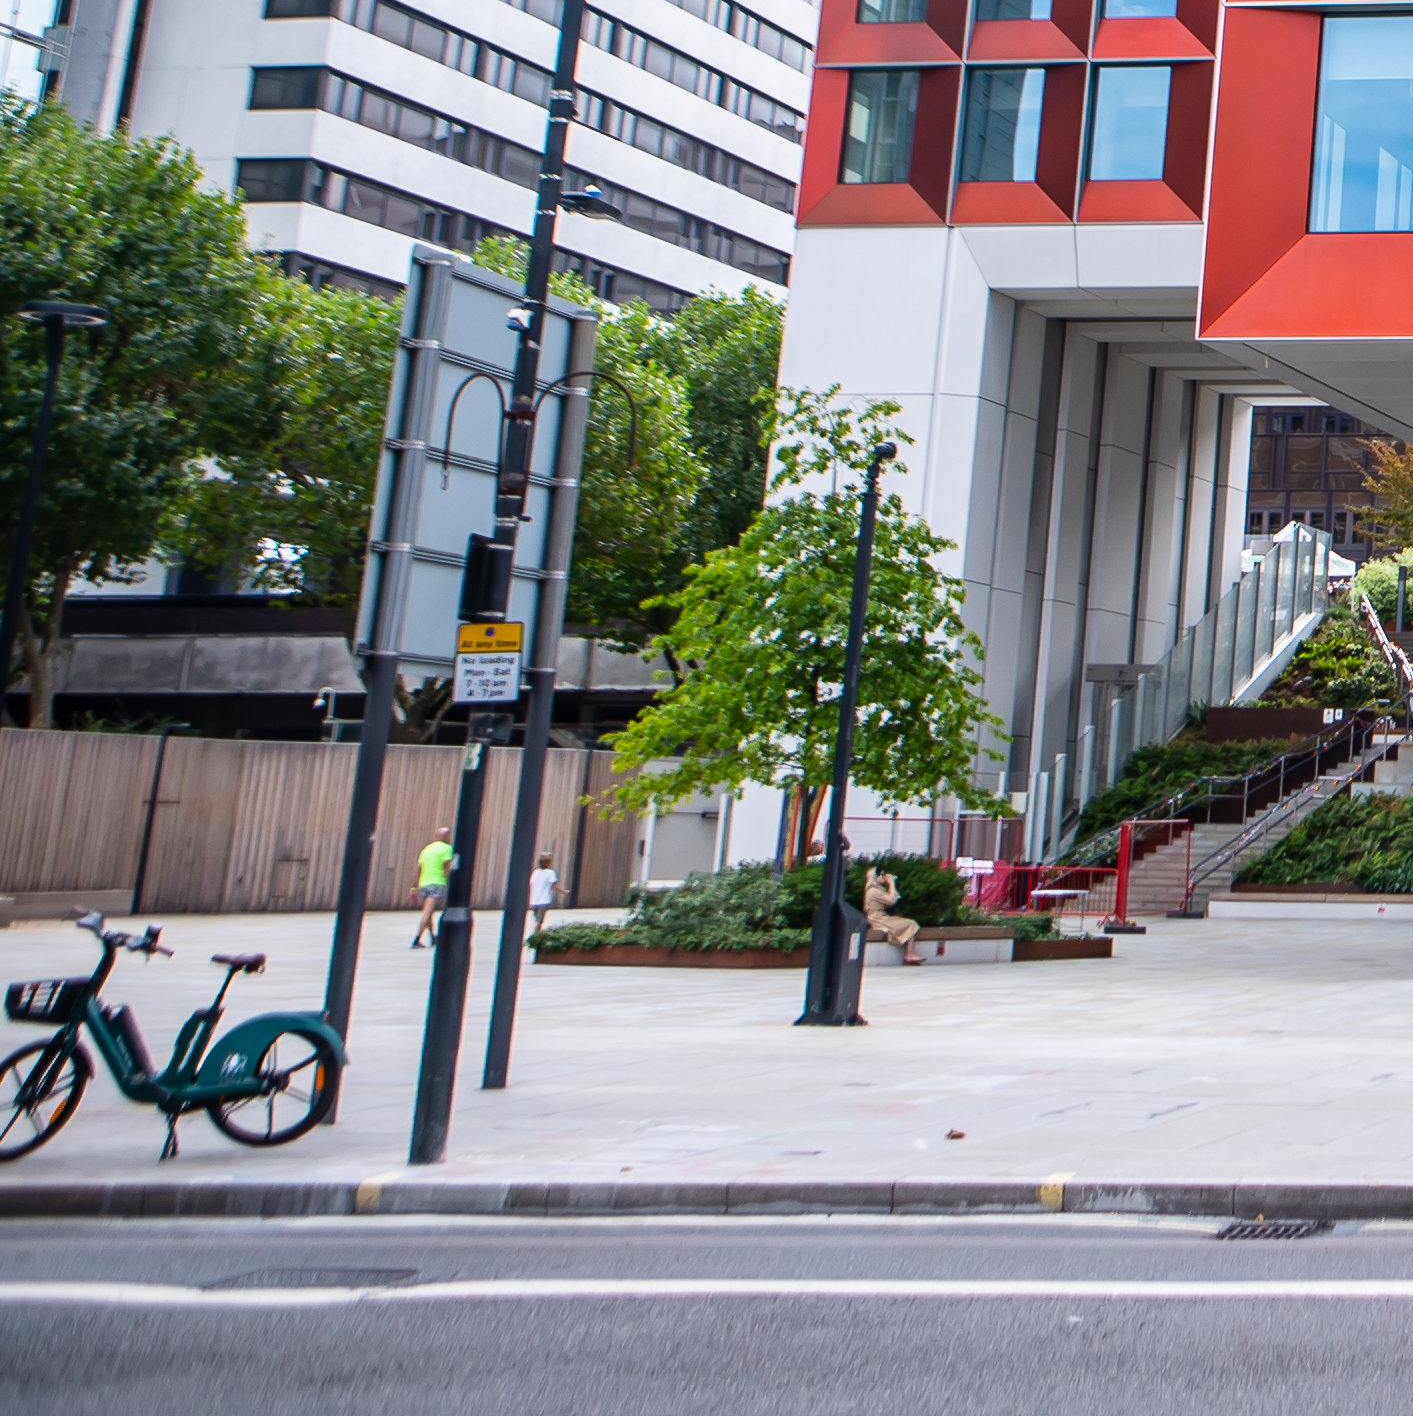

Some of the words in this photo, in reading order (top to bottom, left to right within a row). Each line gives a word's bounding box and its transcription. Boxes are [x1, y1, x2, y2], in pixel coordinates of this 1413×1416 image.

[461, 640, 473, 648] At
[475, 641, 493, 649] any
[461, 656, 476, 664] No
[478, 656, 515, 665] loading
